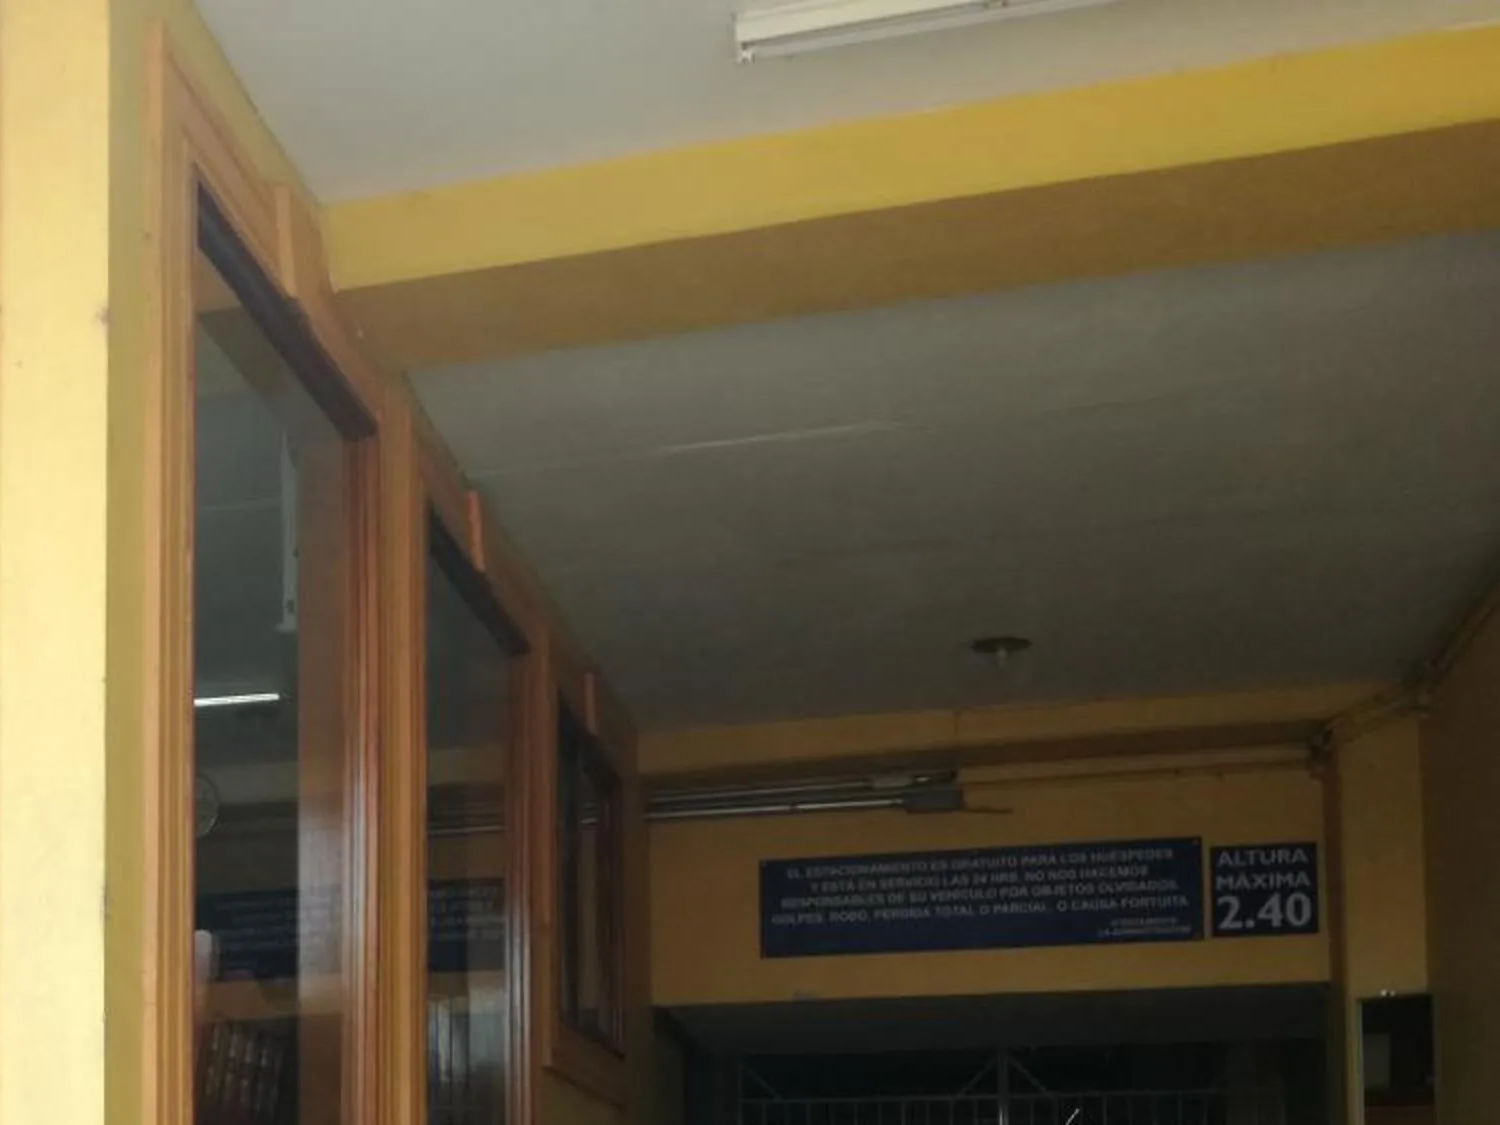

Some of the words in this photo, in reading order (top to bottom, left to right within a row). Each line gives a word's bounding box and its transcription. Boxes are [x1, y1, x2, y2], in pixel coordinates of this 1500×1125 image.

[1021, 854, 1057, 866] PARA
[1216, 848, 1310, 866] ALTURA
[1216, 891, 1312, 930] 2.40
